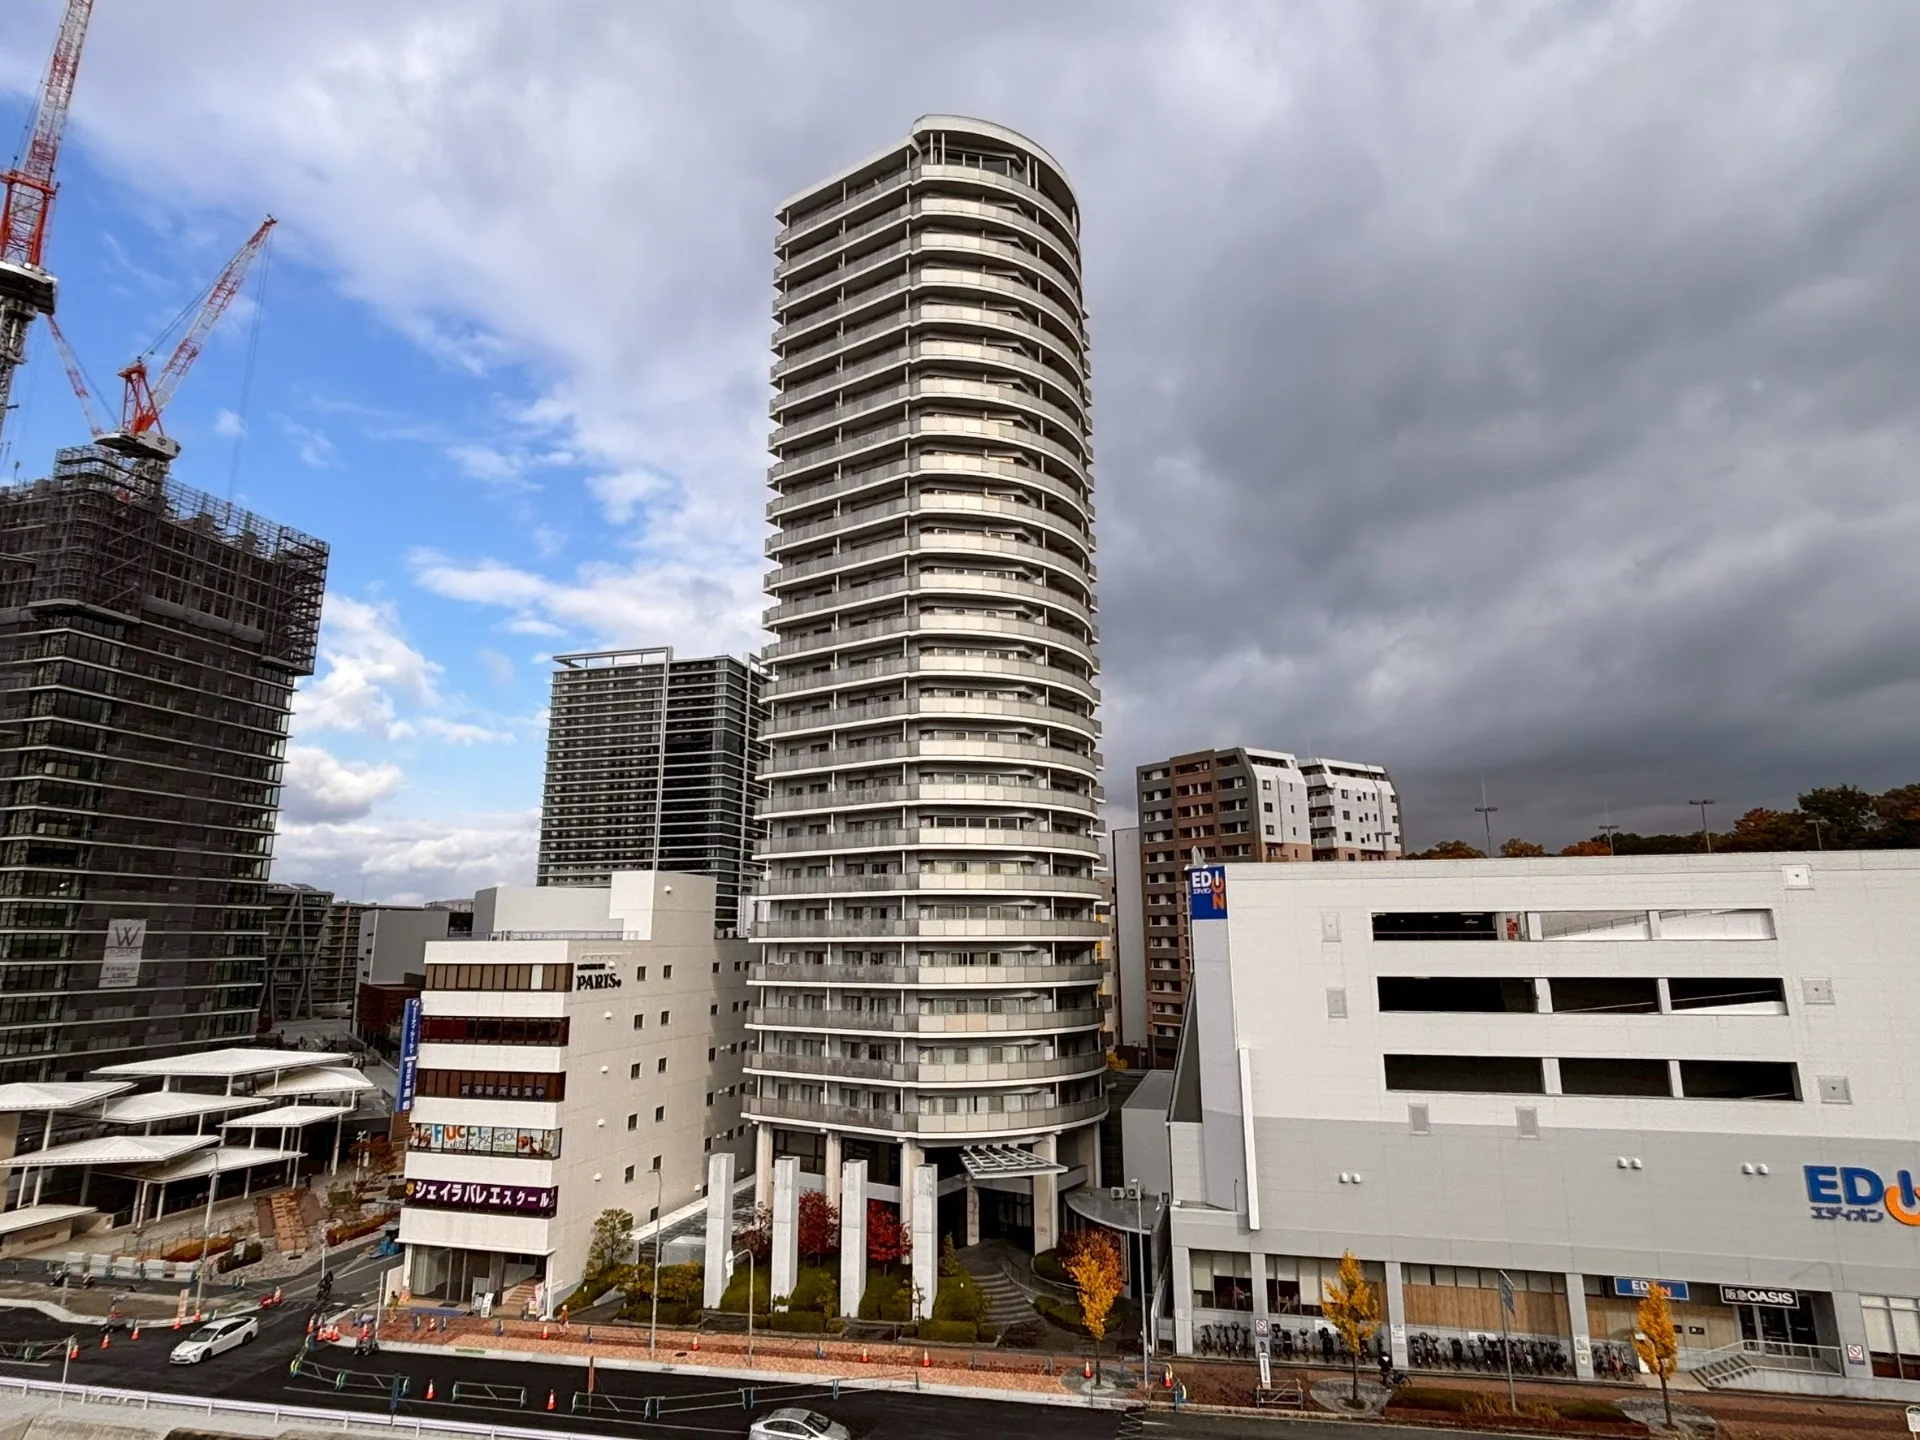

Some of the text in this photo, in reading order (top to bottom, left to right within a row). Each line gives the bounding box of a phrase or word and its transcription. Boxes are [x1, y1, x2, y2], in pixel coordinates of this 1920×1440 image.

[576, 973, 617, 991] PARIS
[415, 1181, 549, 1208] シェイラバレエスクール
[1631, 1280, 1672, 1298] EDN
